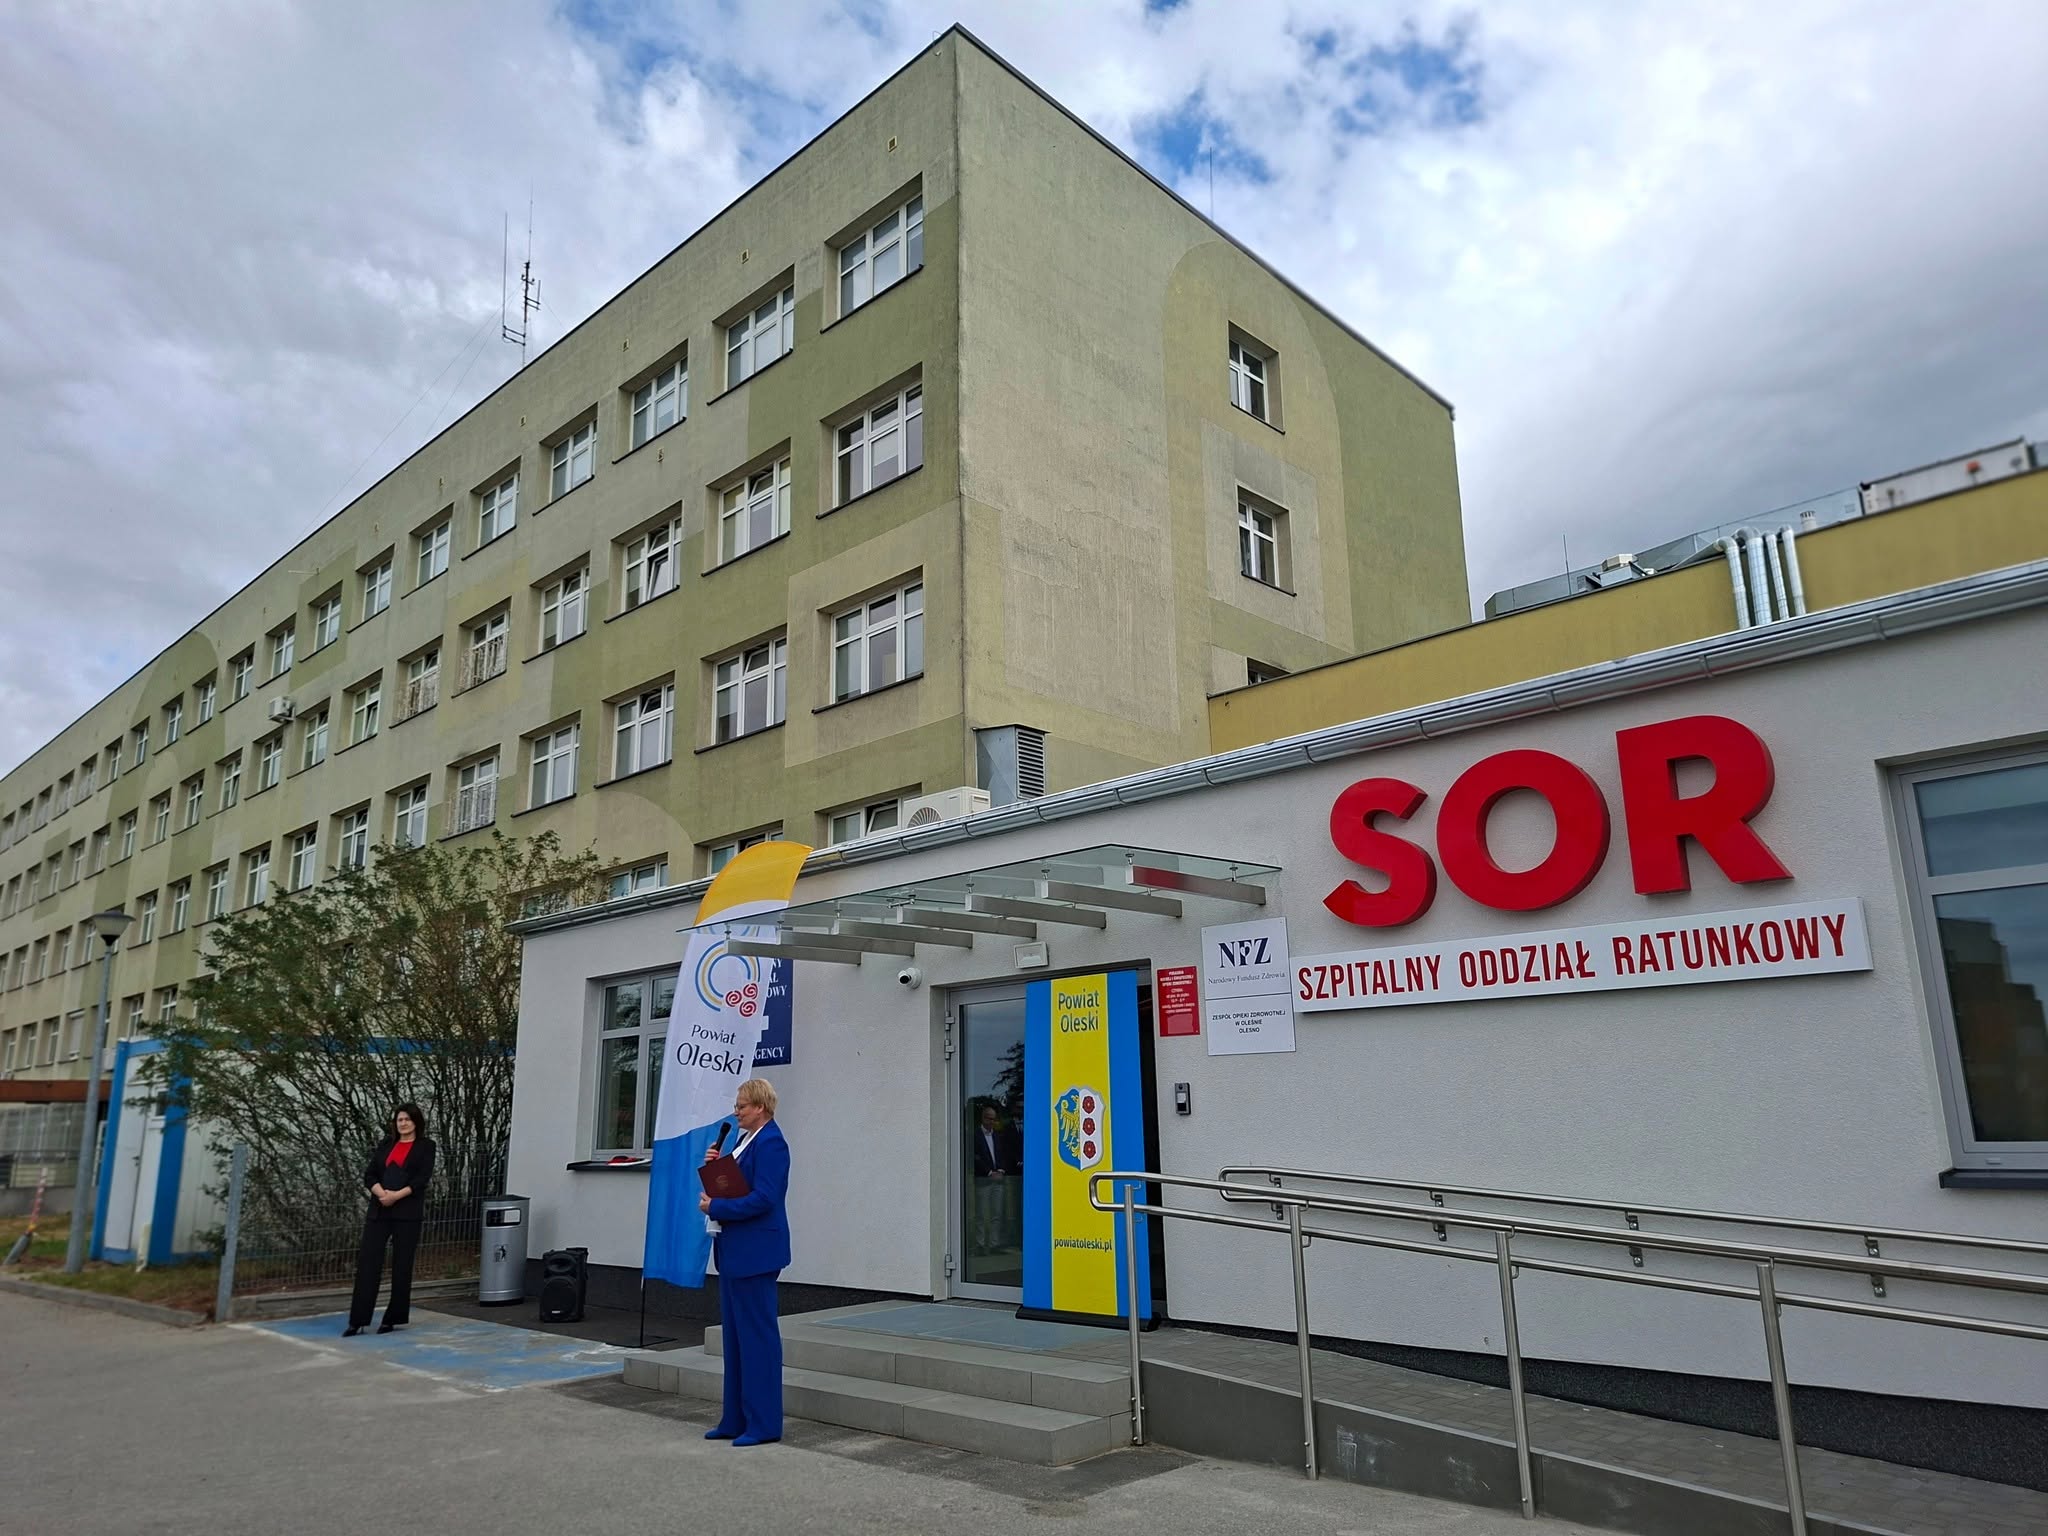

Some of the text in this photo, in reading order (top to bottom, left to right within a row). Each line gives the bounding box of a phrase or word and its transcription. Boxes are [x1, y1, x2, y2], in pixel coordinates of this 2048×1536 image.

[1322, 714, 1795, 927] SOR
[1218, 937, 1272, 969] NFZ
[1297, 913, 1847, 1002] SZPITALNY ODDZIAŁ RATUNKOWY
[1208, 972, 1286, 985] Narodowy Fundusz Zdrowia
[1058, 988, 1100, 1011] Powiat
[1060, 1010, 1099, 1033] Oleski
[1250, 1010, 1286, 1018] ZDROWOTNEJ
[691, 1024, 736, 1045] Powiat
[676, 1042, 744, 1075] Oleski
[753, 1046, 785, 1060] GENCY
[1053, 1236, 1113, 1253] powiatoleski.pl
